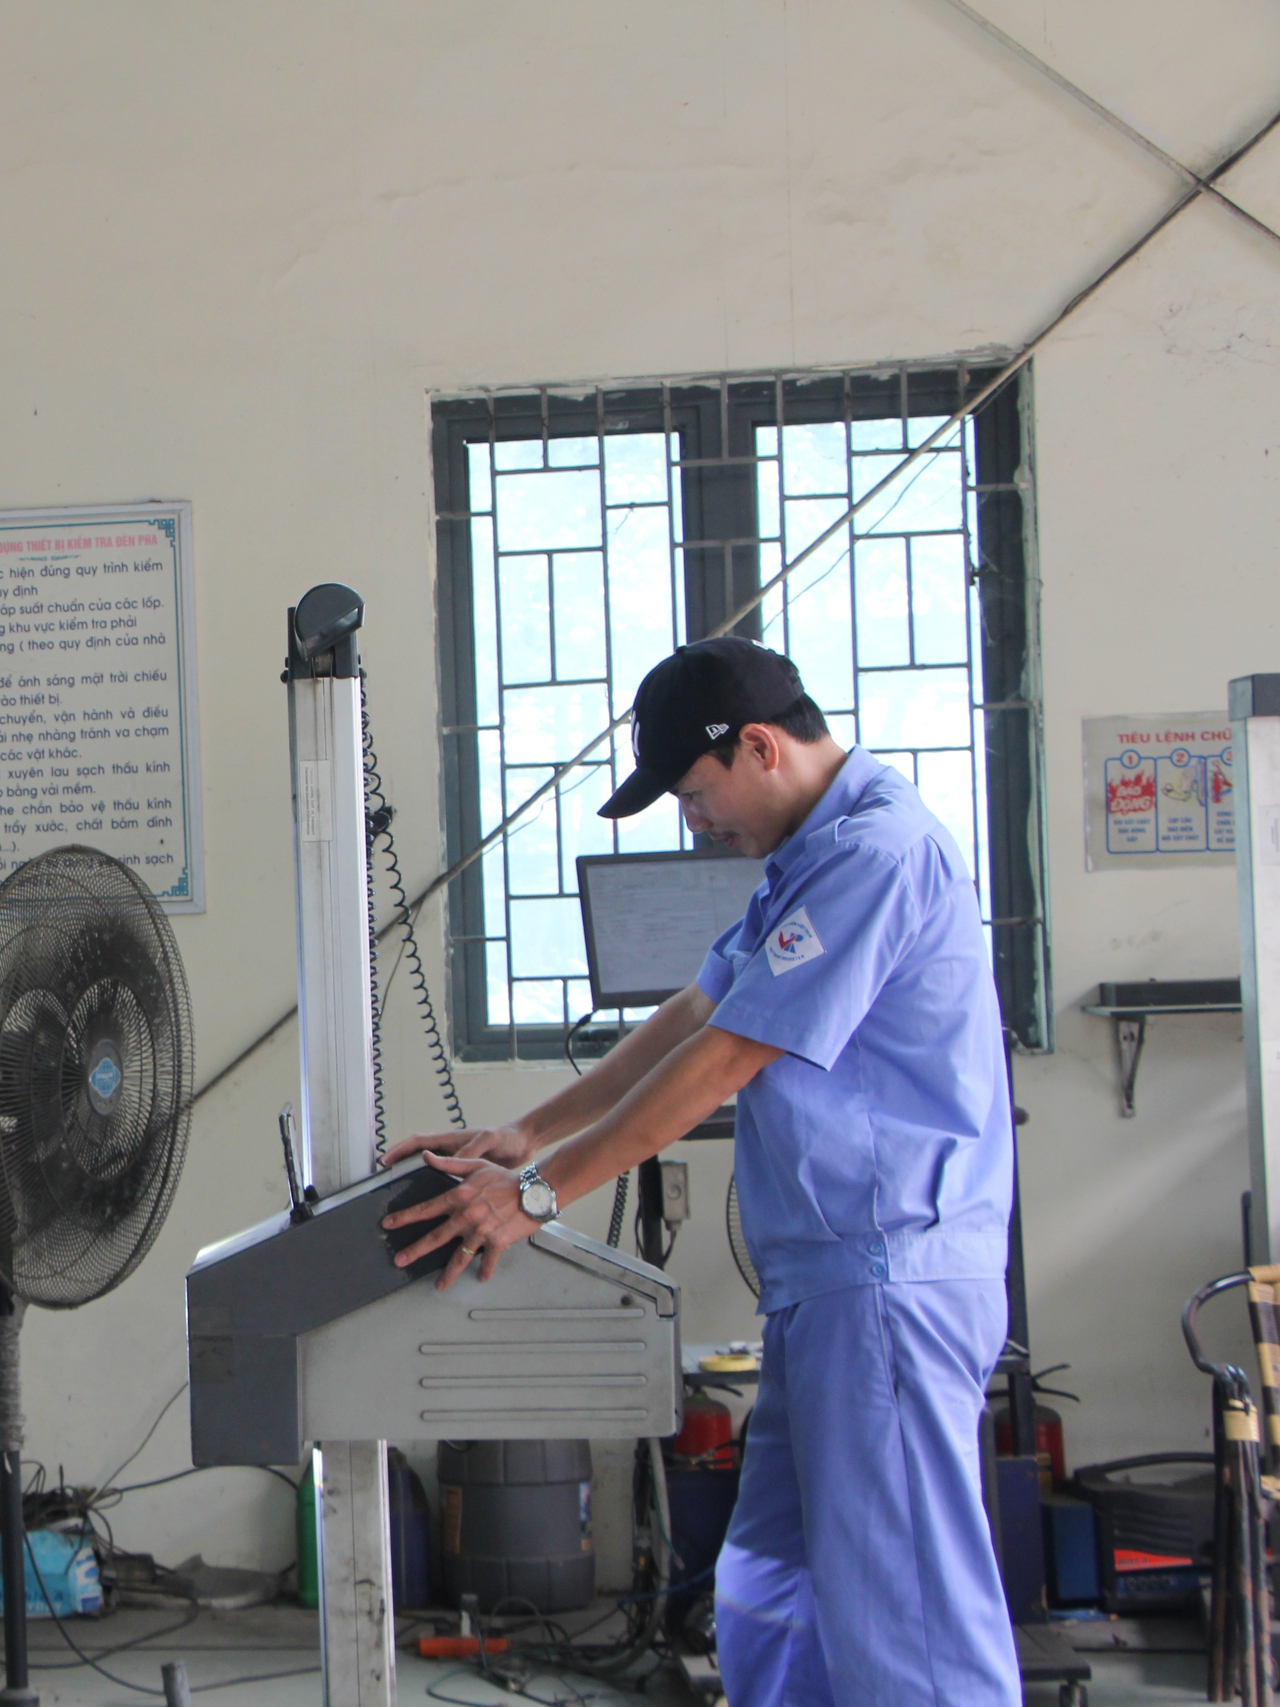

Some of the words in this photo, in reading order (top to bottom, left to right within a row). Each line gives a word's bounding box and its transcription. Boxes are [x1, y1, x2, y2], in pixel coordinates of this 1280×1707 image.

[55, 539, 64, 552] BỊ
[95, 537, 113, 548] TRA
[138, 534, 158, 546] PHA
[10, 567, 34, 580] hiện
[40, 564, 70, 579] đúng
[76, 566, 98, 577] quy
[103, 561, 128, 573] trình
[134, 557, 163, 572] kiểm
[13, 585, 38, 598] định
[0, 603, 16, 617] áp
[20, 601, 43, 615] suất
[89, 597, 111, 611] của
[115, 597, 138, 610] các
[9, 623, 30, 633] khu
[34, 623, 55, 634] vực
[59, 616, 88, 630] kiểm
[92, 619, 107, 629] tra
[111, 614, 137, 630] phải
[28, 640, 54, 650] theo
[59, 640, 80, 650] quy
[86, 636, 111, 650] định
[116, 633, 138, 646] của
[143, 632, 166, 644] nhà
[18, 676, 40, 687] ánh
[47, 674, 75, 688] sáng
[81, 672, 104, 686] mặt
[110, 671, 128, 683] trời
[134, 668, 167, 682] chiếu
[20, 692, 45, 705] thiết
[54, 710, 75, 724] vận
[83, 709, 113, 721] hành
[120, 707, 135, 719] và
[12, 731, 33, 744] nhẹ
[38, 729, 75, 742] nhàng
[81, 727, 111, 739] tránh
[115, 728, 130, 738] va
[135, 726, 169, 739] chạm
[0, 749, 23, 761] các
[27, 748, 45, 762] vật
[8, 766, 43, 780] xuyên
[51, 766, 69, 777] lau
[77, 764, 105, 778] sạch
[146, 761, 170, 773] kính
[41, 783, 59, 796] vải
[60, 800, 84, 813] bảo
[91, 800, 105, 814] vệ
[147, 797, 172, 809] kính
[76, 817, 103, 831] chất
[111, 817, 138, 829] bám
[145, 853, 174, 866] sạch
